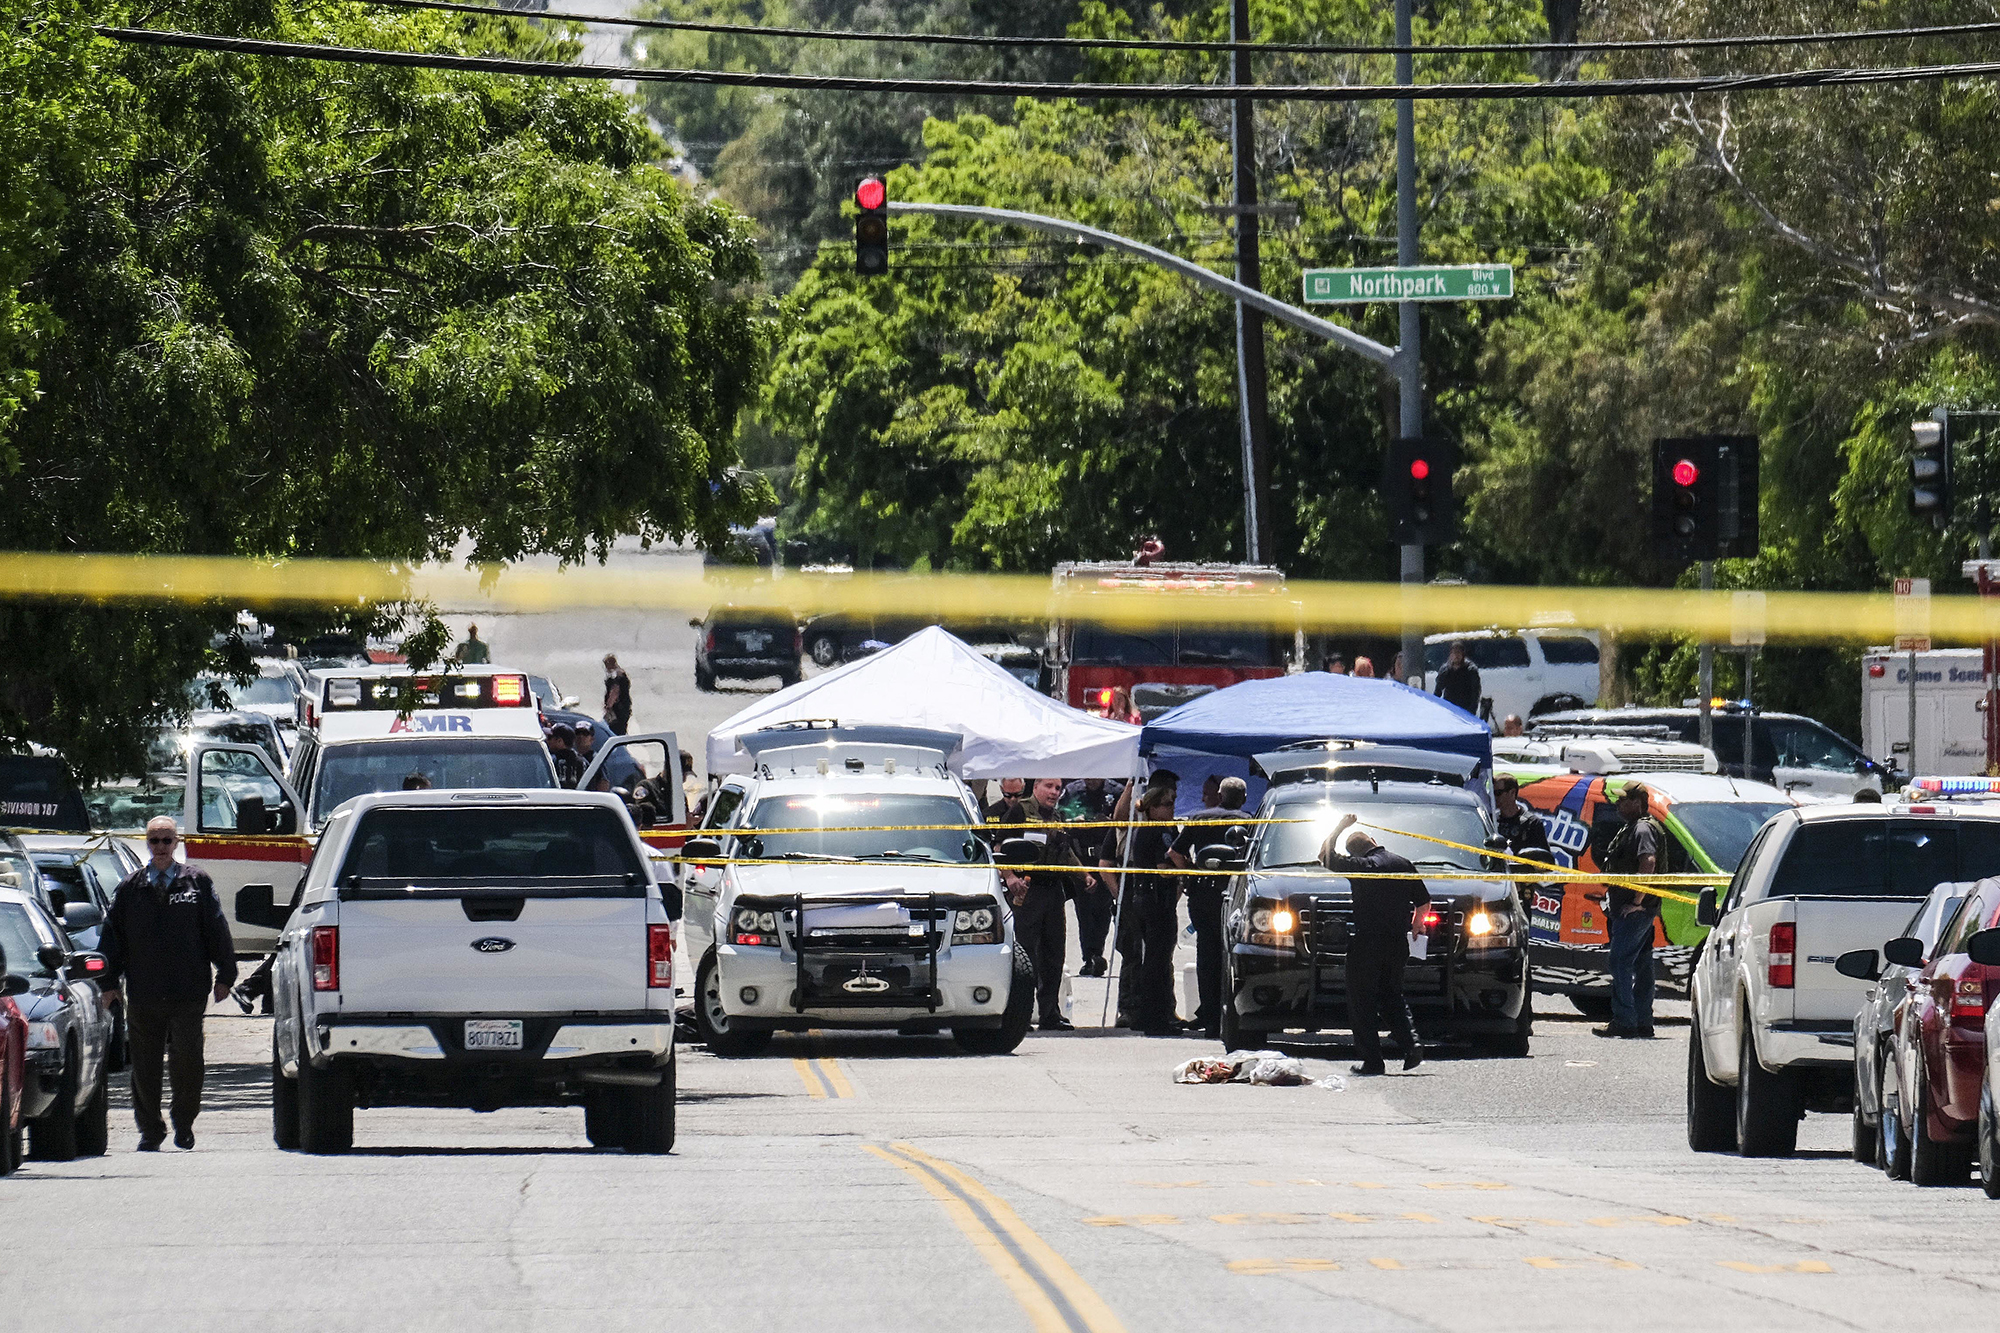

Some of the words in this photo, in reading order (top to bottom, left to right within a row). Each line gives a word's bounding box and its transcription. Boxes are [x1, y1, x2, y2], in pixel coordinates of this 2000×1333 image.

[1472, 269, 1495, 282] Blvd
[1350, 273, 1447, 299] Northpark
[1492, 283, 1501, 295] W
[1897, 581, 1910, 594] NO
[388, 715, 474, 734] AMR
[169, 889, 201, 905] POLICE
[1531, 916, 1561, 931] RIALTO
[480, 940, 506, 951] Ford
